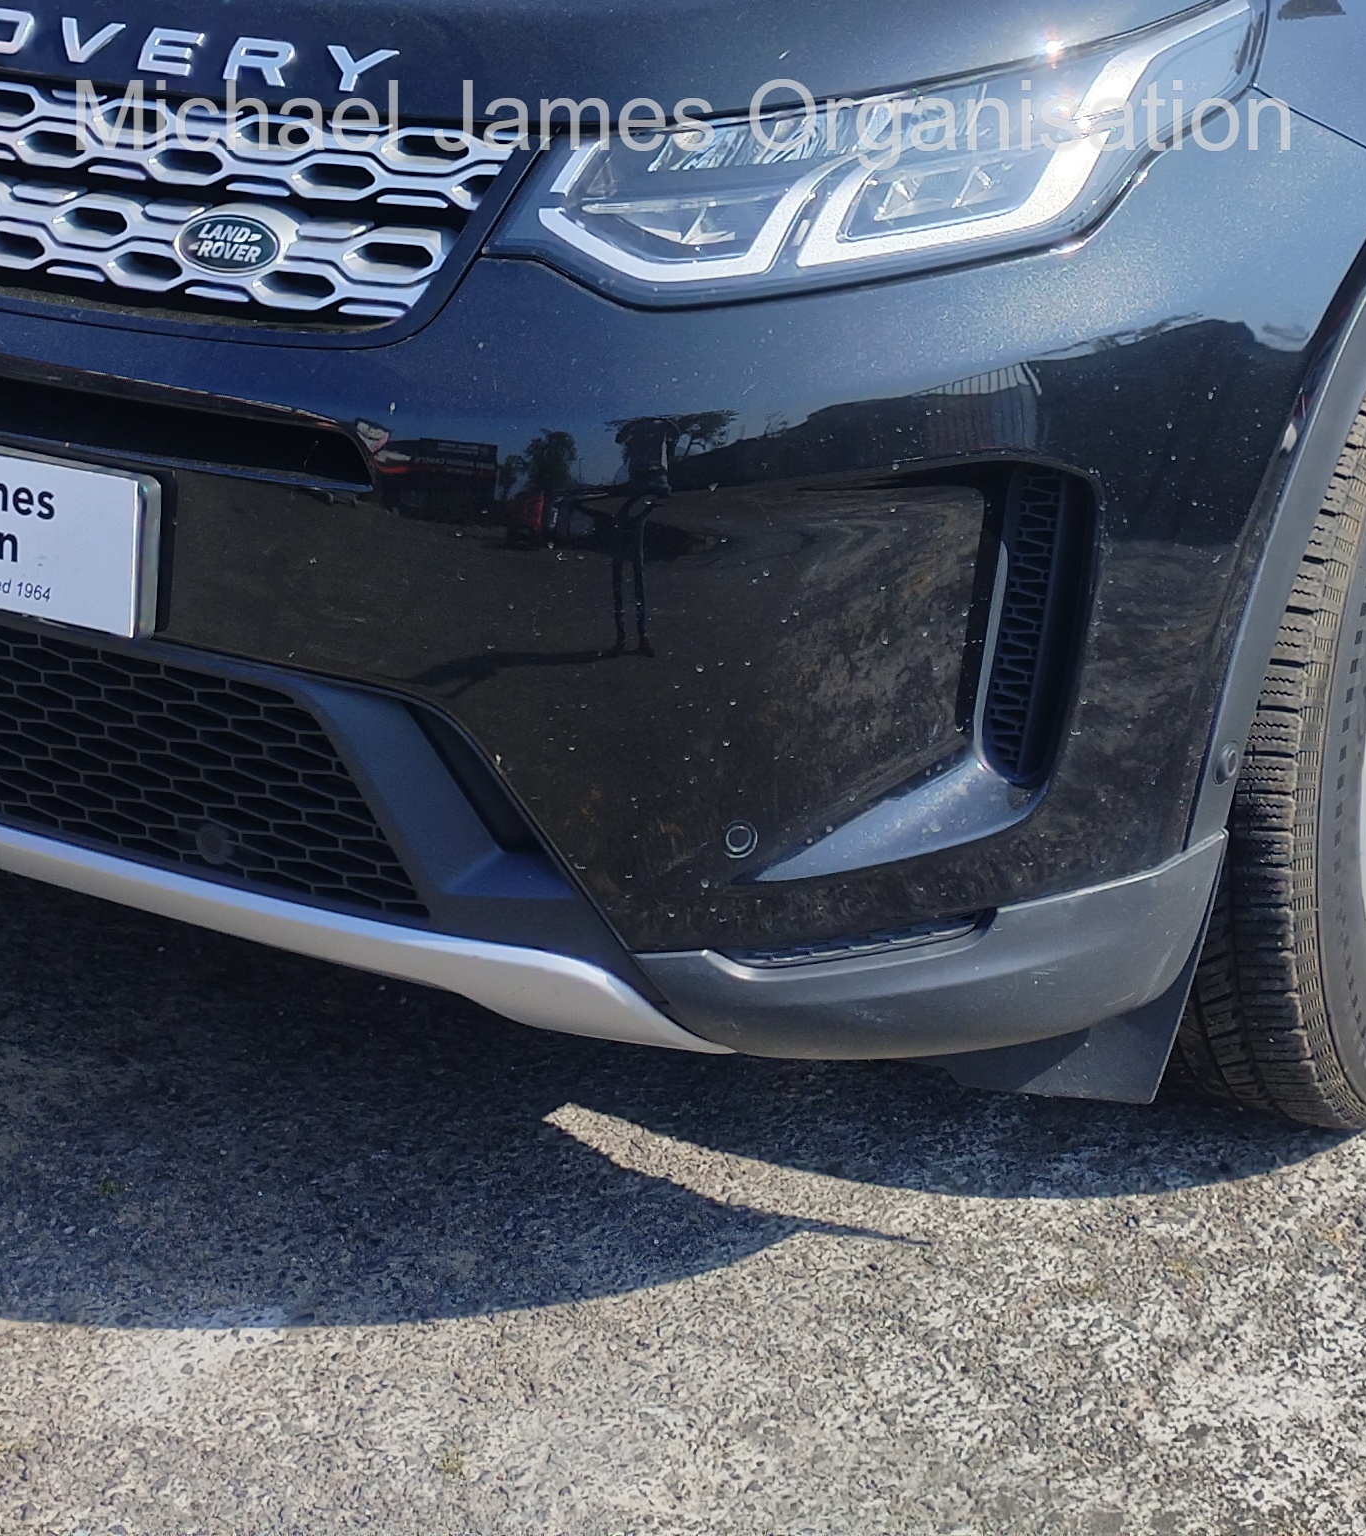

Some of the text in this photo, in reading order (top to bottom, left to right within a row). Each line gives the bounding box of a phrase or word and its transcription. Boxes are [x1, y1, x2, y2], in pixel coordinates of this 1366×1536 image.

[197, 222, 252, 244] LAND
[196, 239, 262, 264] ROVER
[15, 581, 53, 603] 1964
